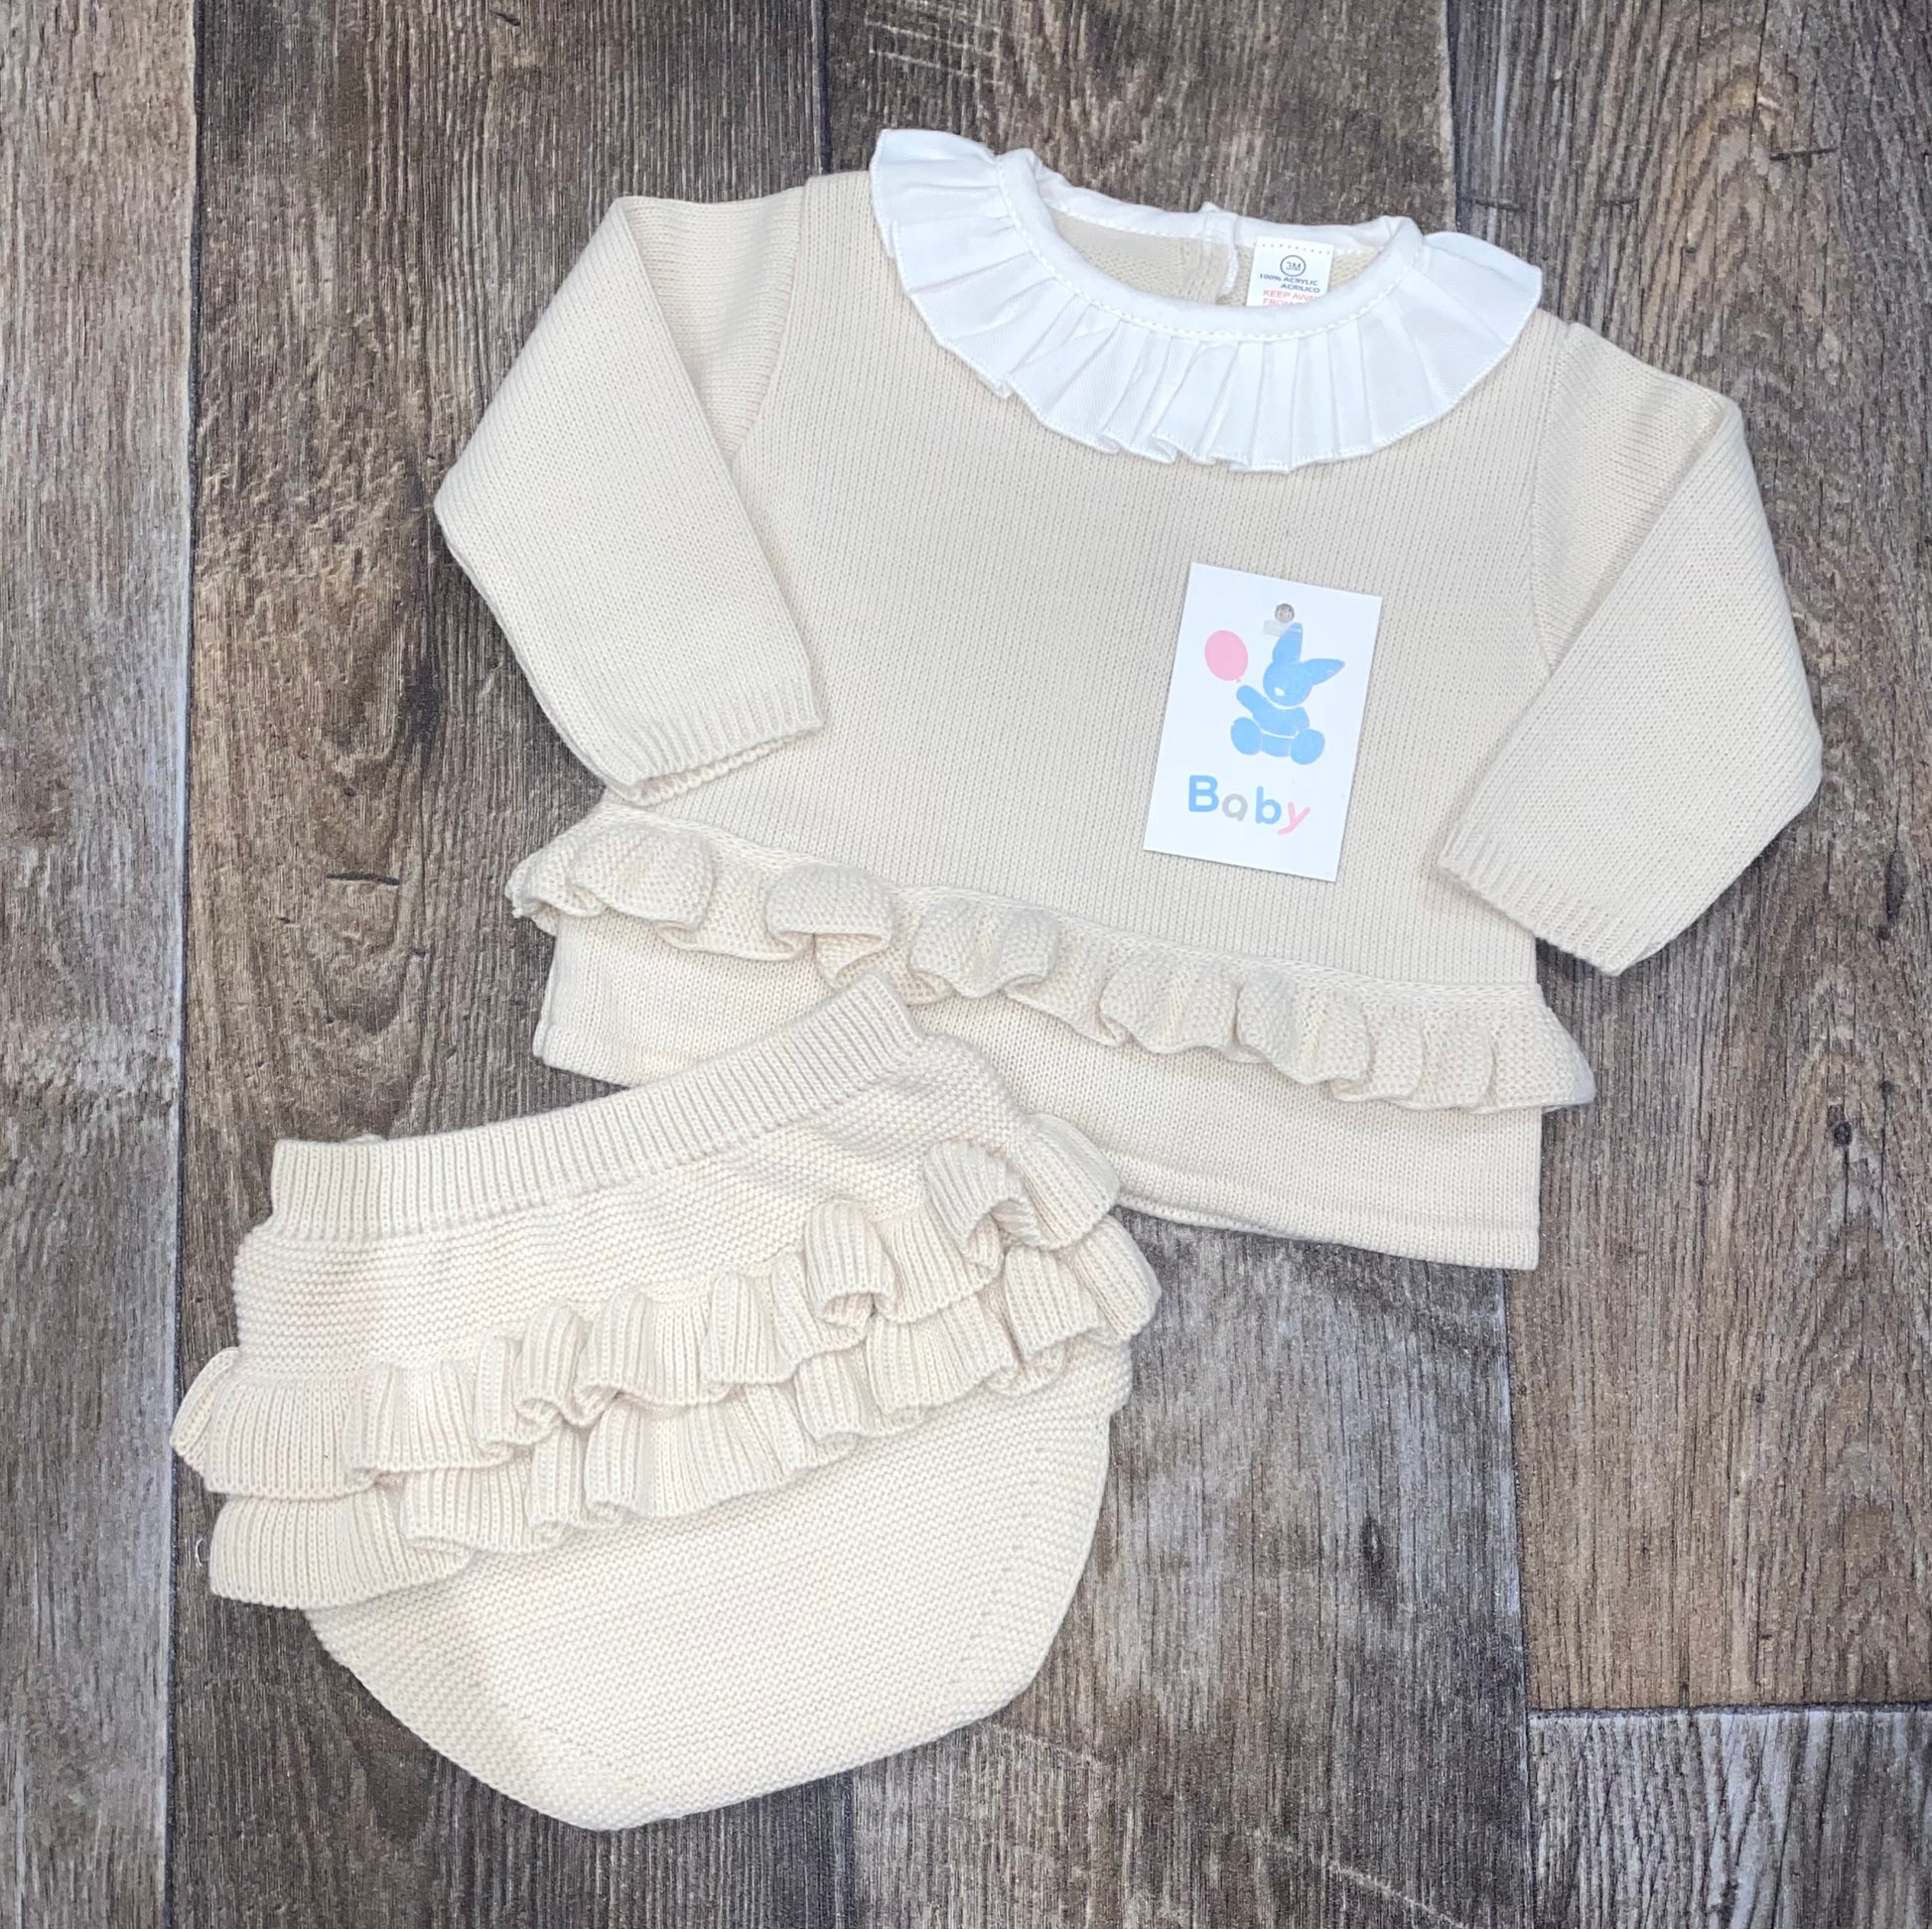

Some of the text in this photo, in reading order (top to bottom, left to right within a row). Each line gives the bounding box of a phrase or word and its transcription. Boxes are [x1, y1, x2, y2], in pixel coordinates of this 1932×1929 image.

[1286, 261, 1302, 271] 3M
[1283, 277, 1318, 286] ACRYLIC
[1280, 283, 1320, 293] ACRILICO
[1263, 289, 1291, 298] KEEP
[1188, 774, 1311, 835] Baby
